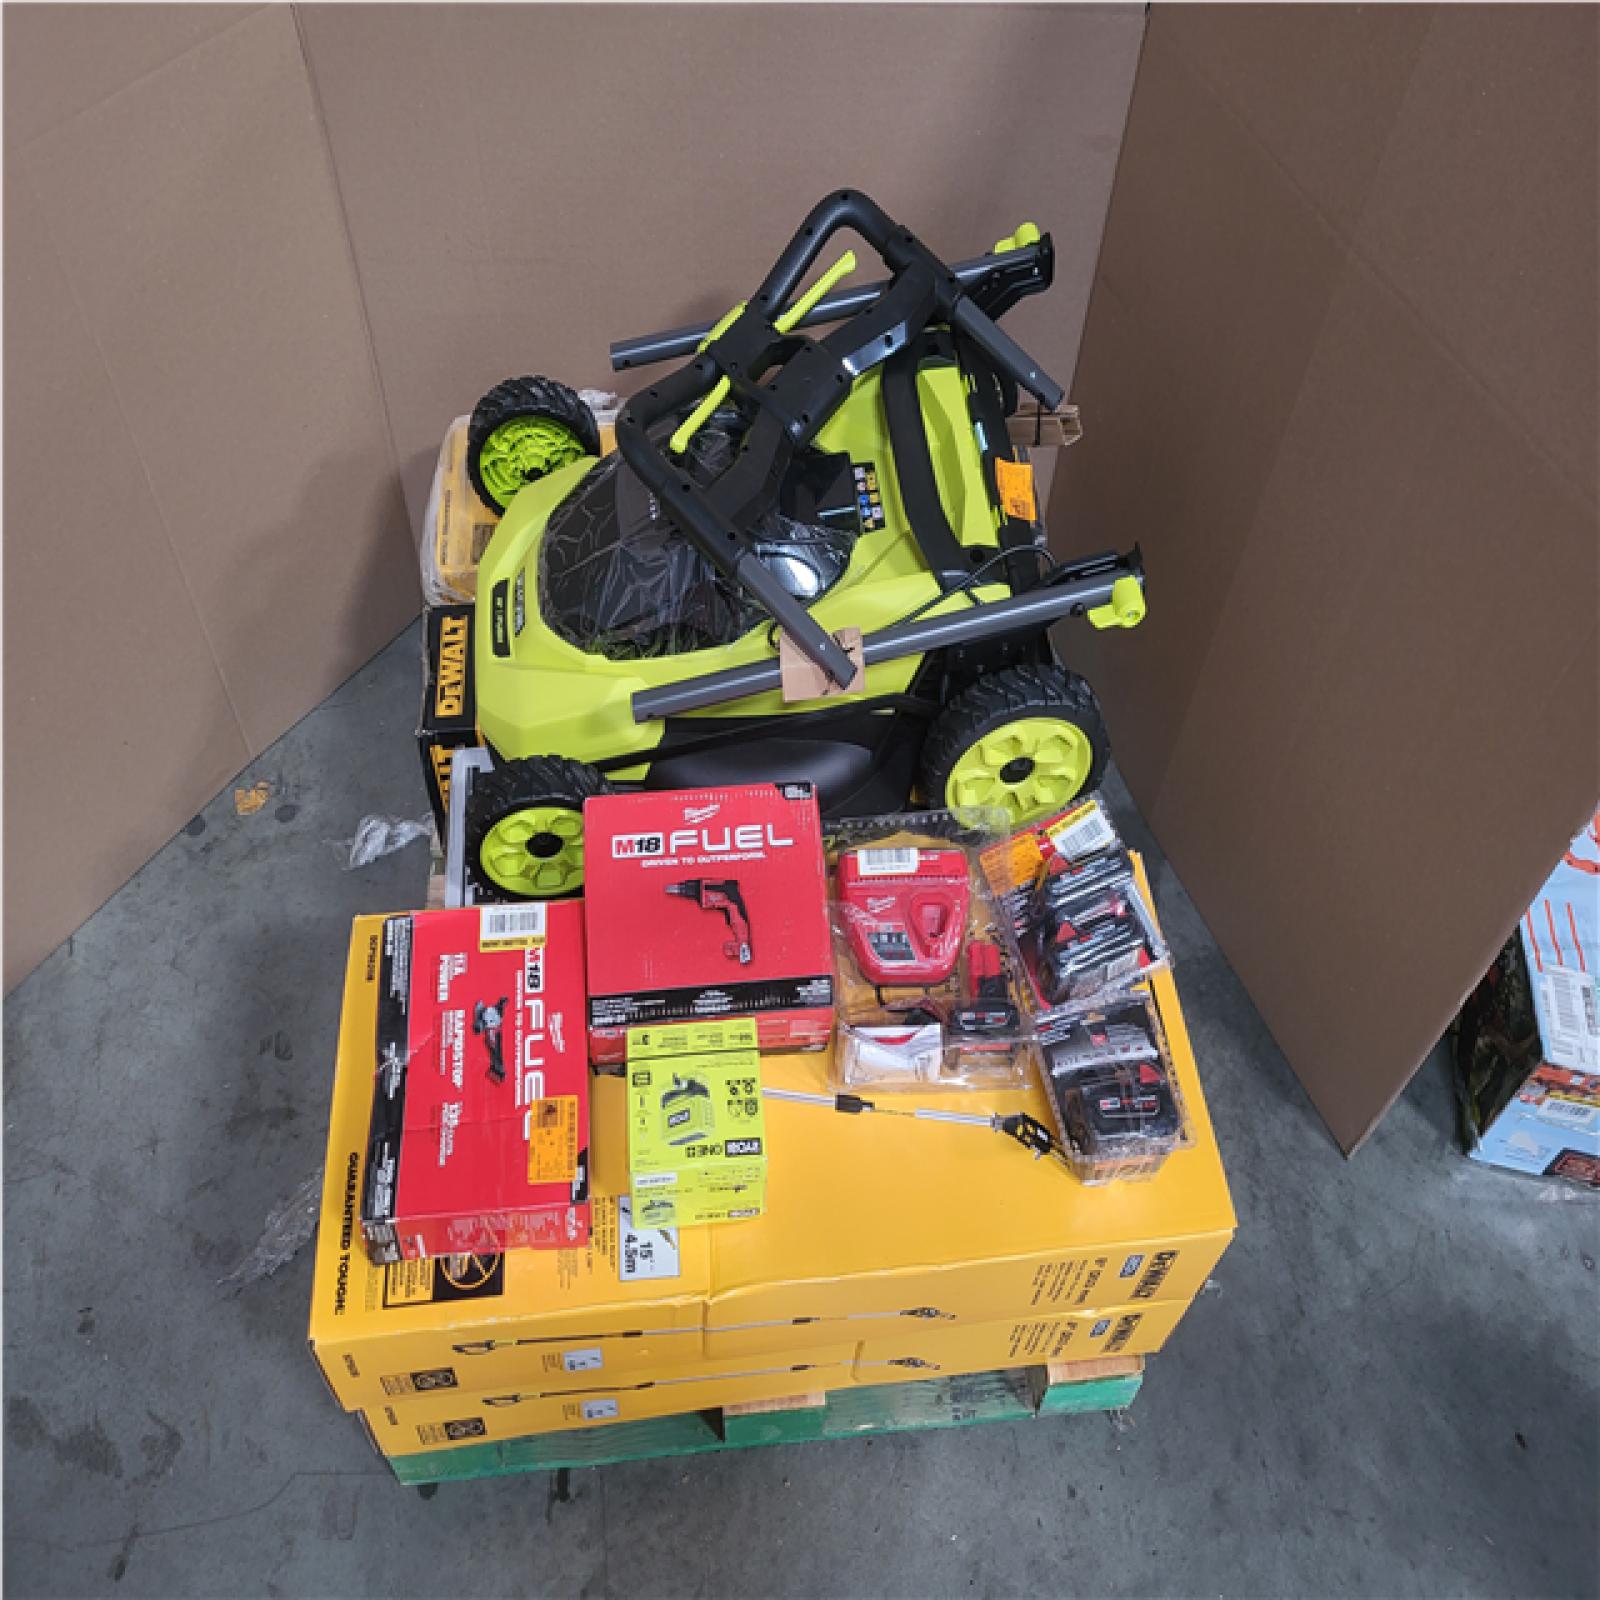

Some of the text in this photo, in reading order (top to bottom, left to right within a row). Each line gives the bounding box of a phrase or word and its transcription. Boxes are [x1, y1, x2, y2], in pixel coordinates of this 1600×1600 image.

[434, 615, 468, 717] DEWALT
[614, 822, 794, 857] M18 FUEL
[640, 858, 678, 868] DRIVEN
[682, 857, 695, 866] TO
[339, 1151, 360, 1250] GUARANTEED
[624, 1233, 639, 1274] 4.5m
